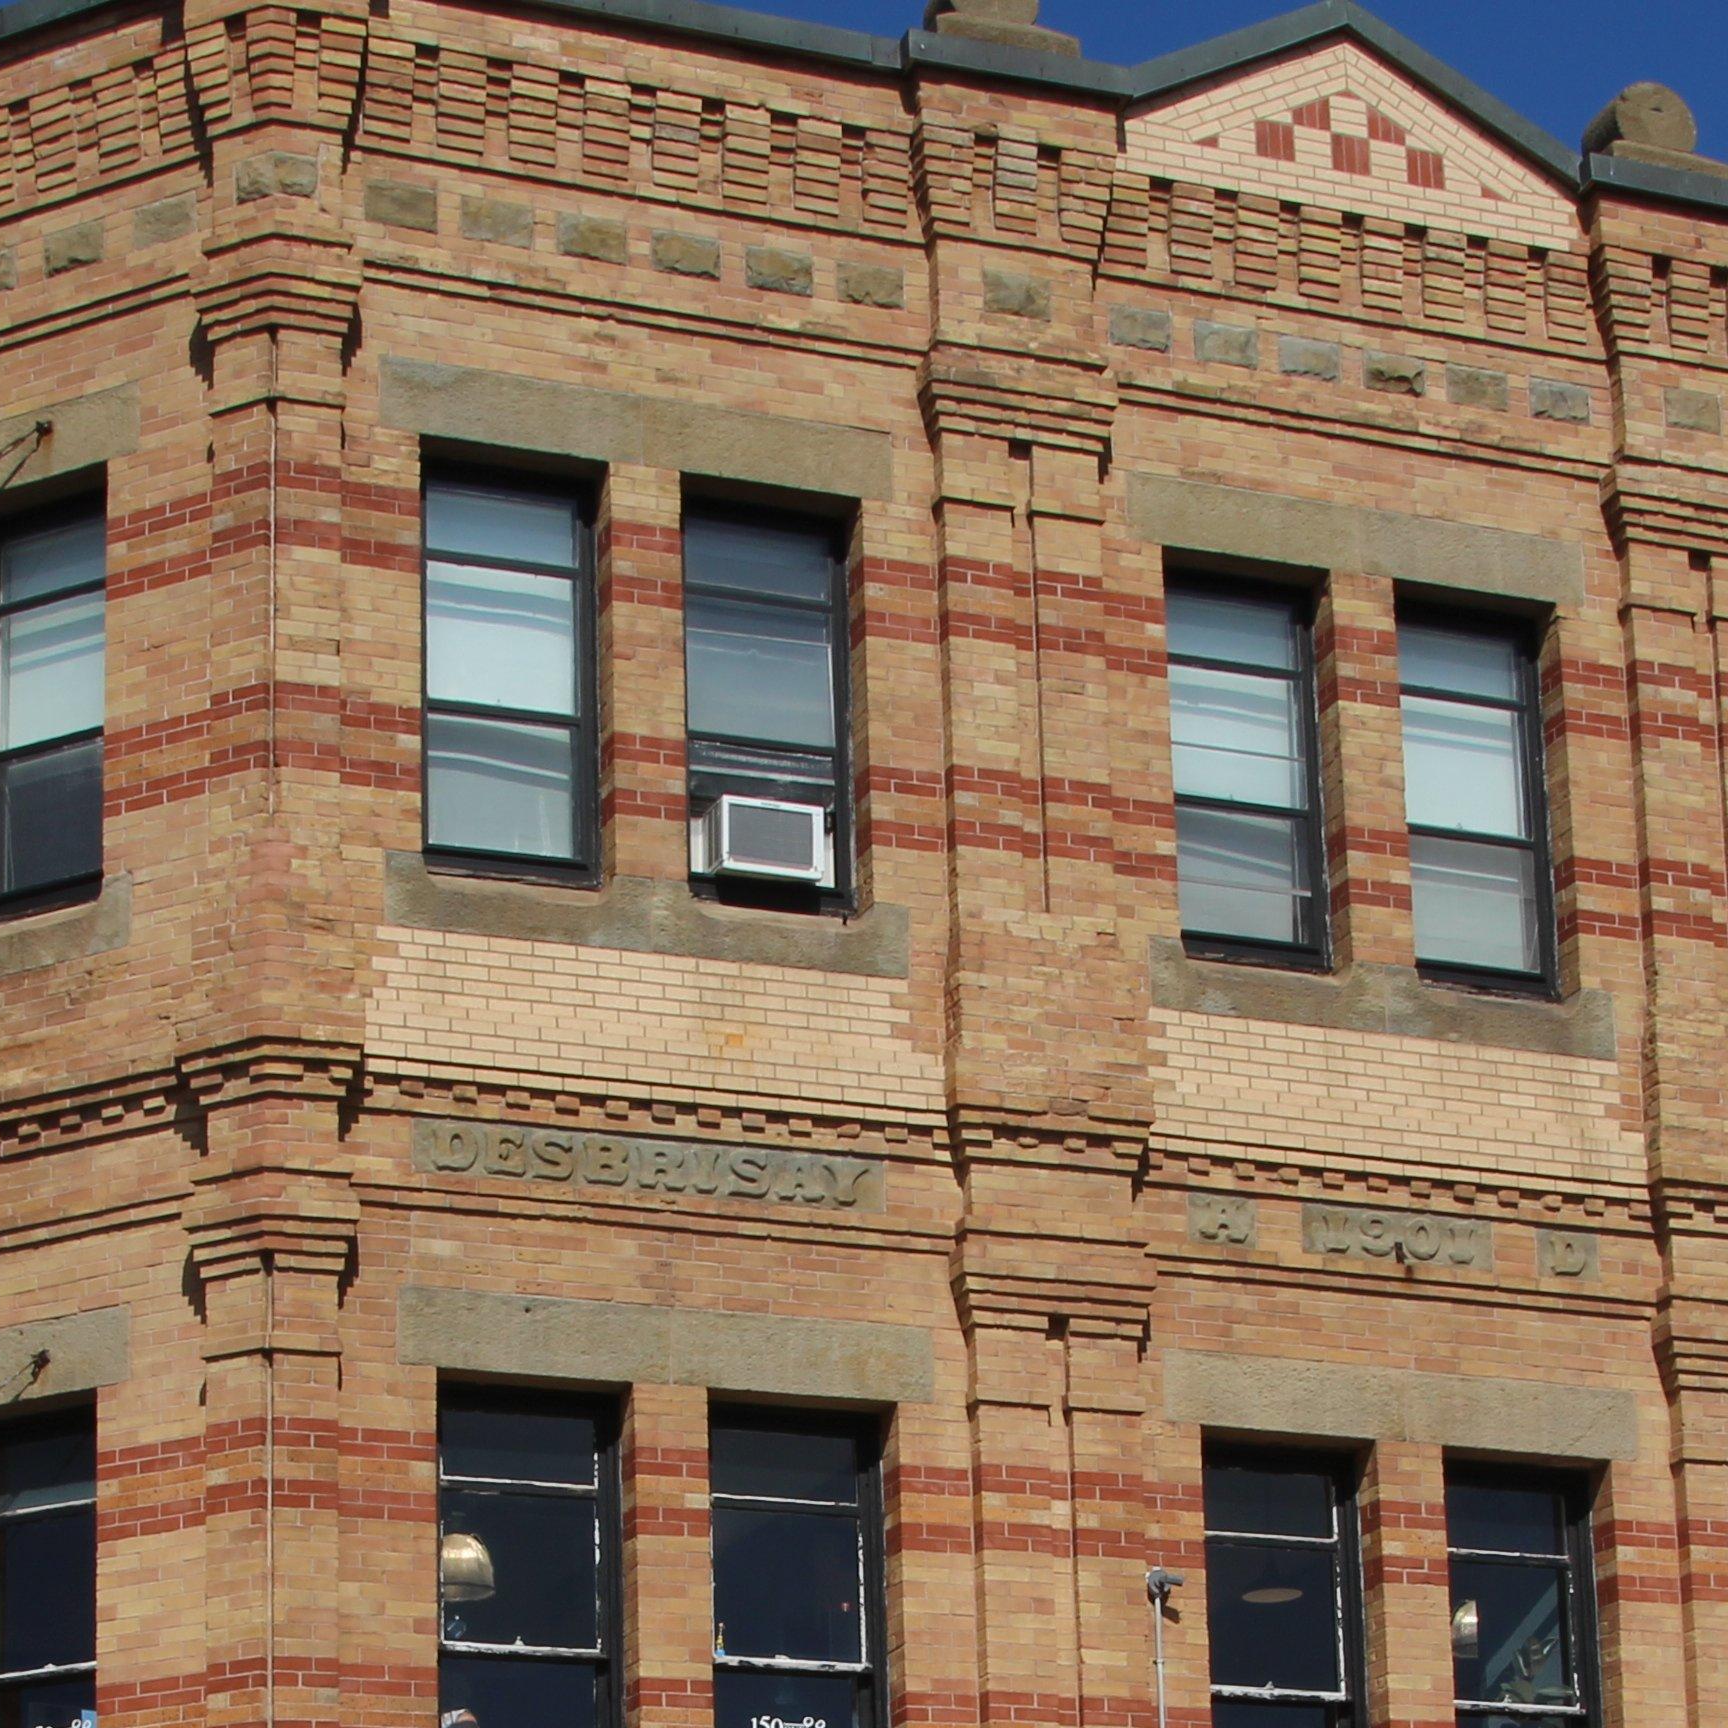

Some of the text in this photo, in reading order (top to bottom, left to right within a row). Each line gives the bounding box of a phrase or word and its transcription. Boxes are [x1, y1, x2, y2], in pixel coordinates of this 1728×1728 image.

[432, 1125, 872, 1208] DESBRISAY
[1198, 1197, 1250, 1245] A
[1321, 1210, 1477, 1265] 1901
